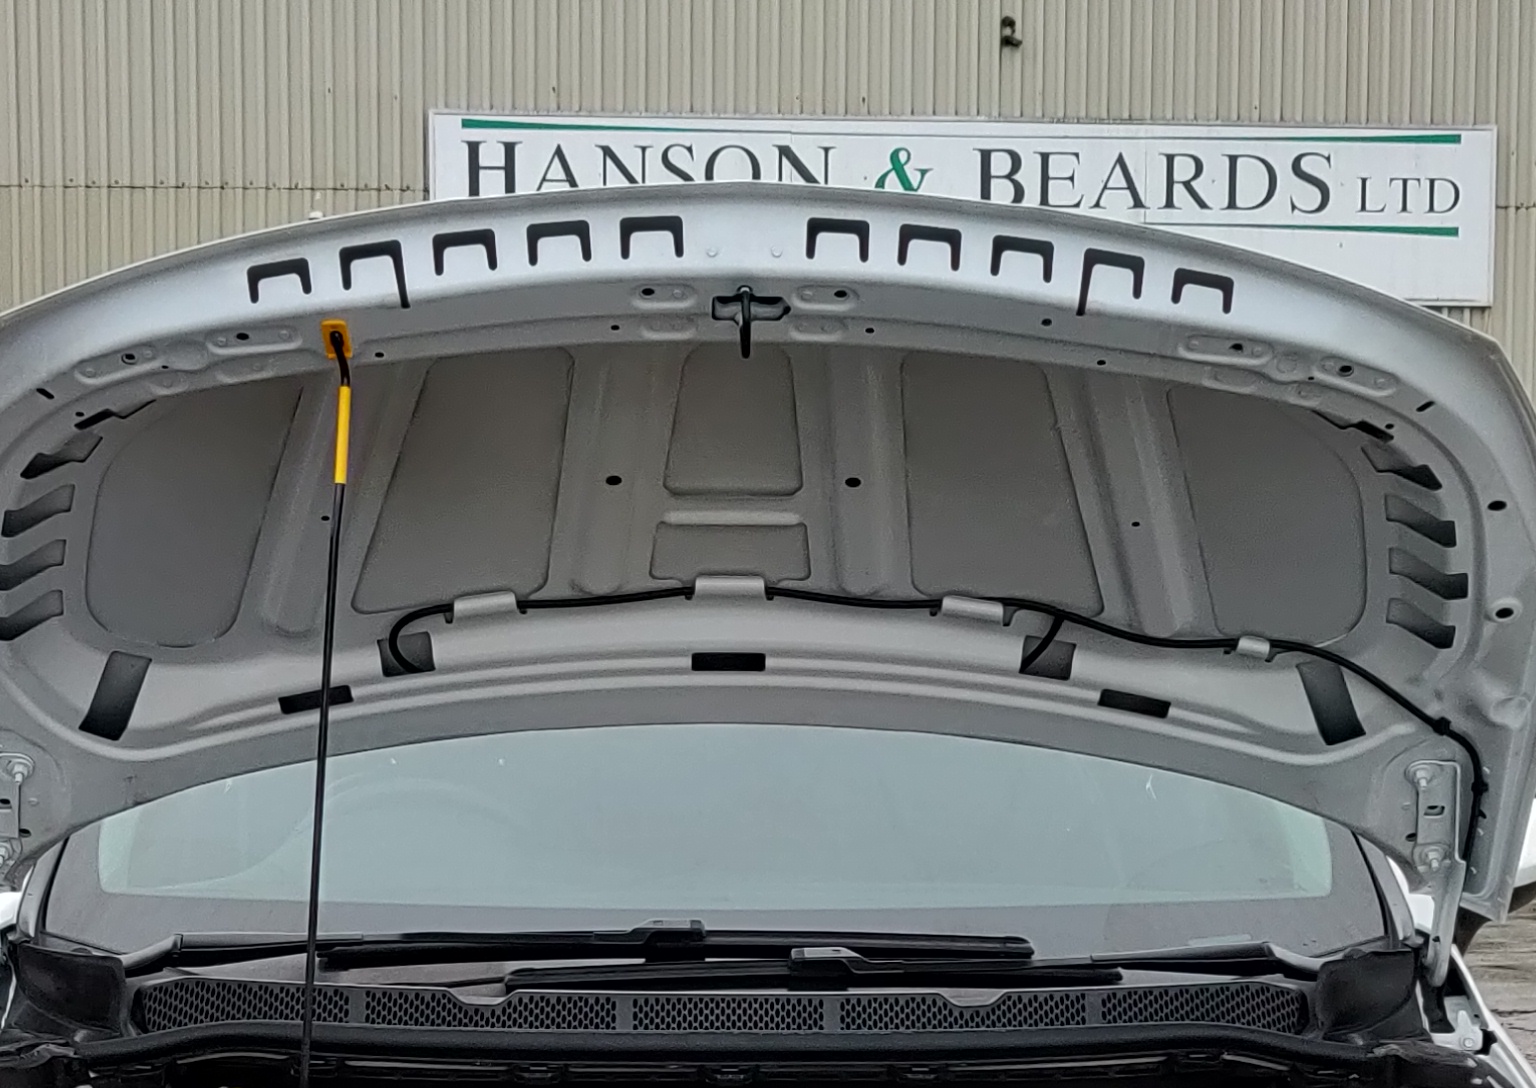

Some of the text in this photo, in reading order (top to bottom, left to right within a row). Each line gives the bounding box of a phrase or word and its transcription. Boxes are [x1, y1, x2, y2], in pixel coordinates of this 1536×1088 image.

[462, 139, 837, 196] HANSON
[973, 147, 1333, 215] BEARDS
[1357, 176, 1461, 214] LTD
